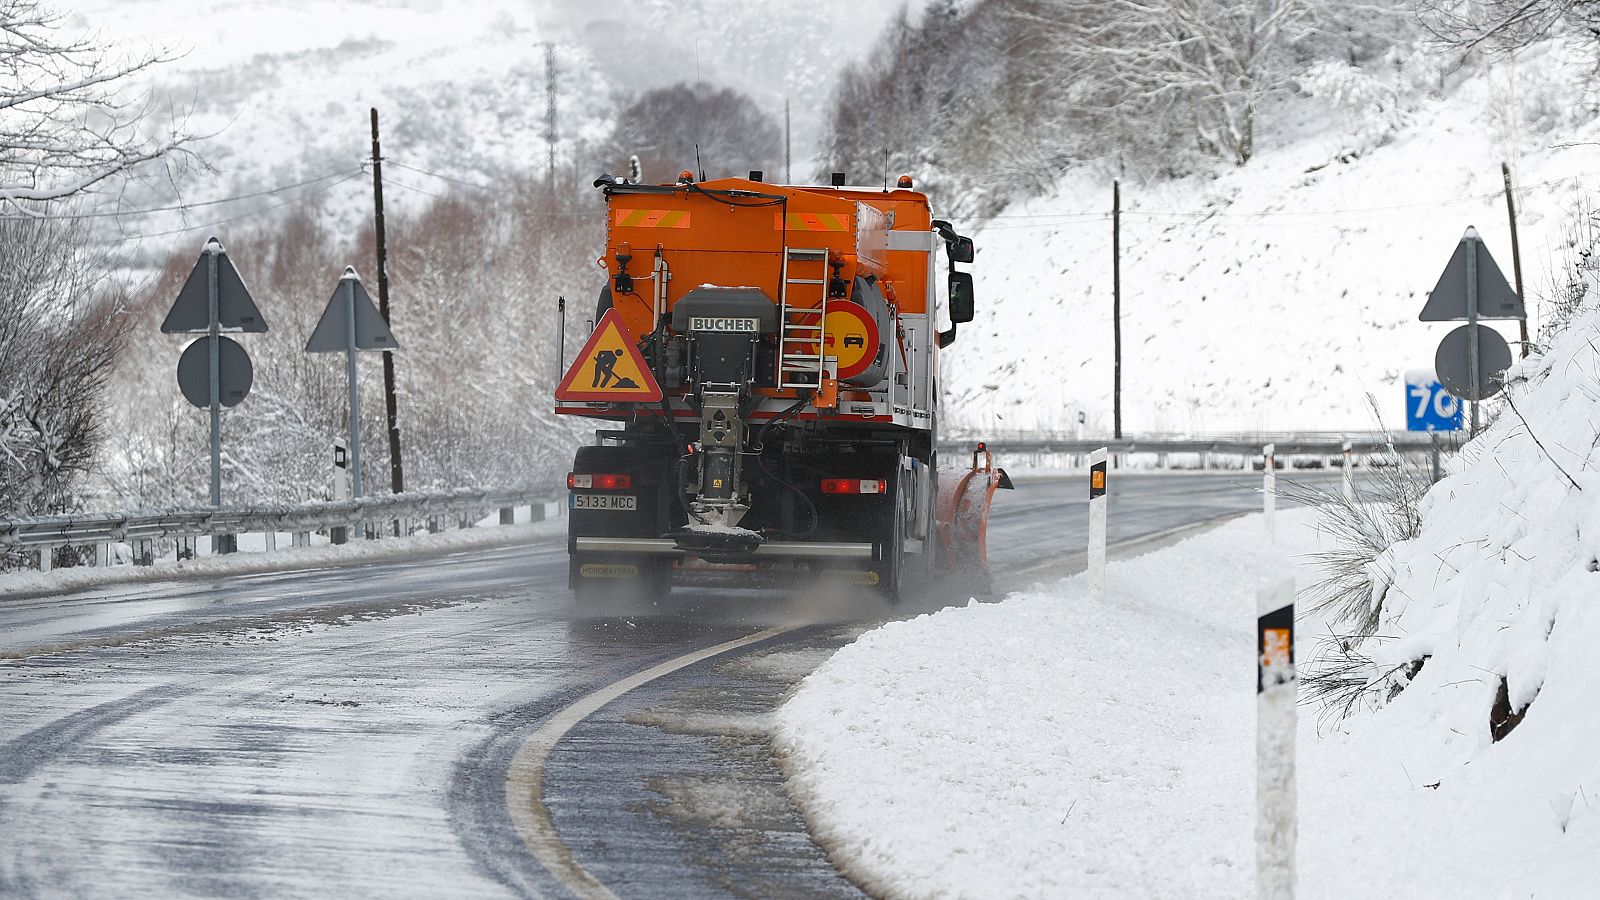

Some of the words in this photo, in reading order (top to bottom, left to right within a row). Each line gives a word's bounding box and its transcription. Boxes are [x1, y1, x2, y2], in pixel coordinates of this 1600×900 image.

[693, 319, 755, 331] BUCHER
[1411, 388, 1459, 419] 70
[576, 495, 606, 508] 5133
[611, 496, 634, 509] MCC
